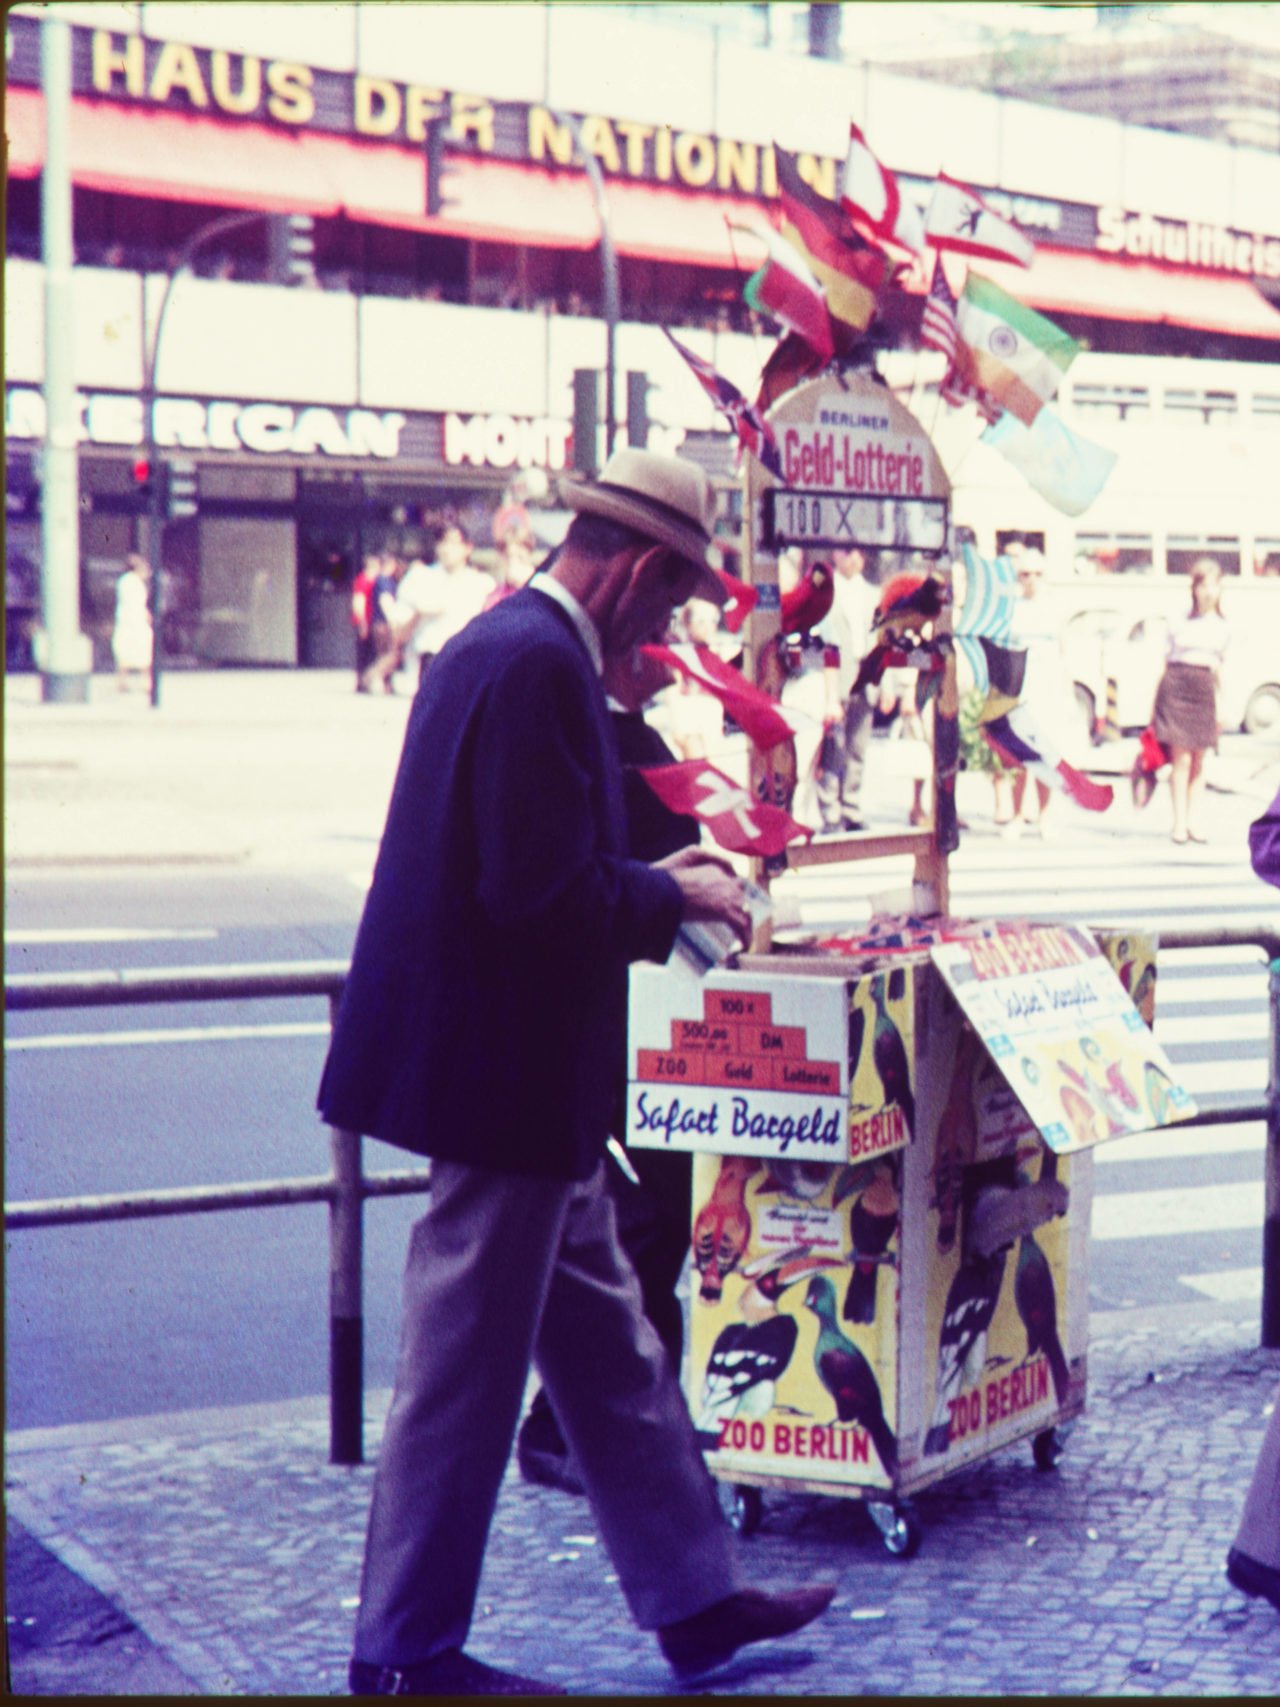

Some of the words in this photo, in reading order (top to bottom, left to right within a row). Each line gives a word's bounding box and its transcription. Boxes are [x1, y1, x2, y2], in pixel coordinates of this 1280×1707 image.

[92, 29, 315, 124] HAUS
[5, 388, 407, 458] AERICAN
[820, 410, 889, 430] BERLINER
[785, 428, 923, 495] Geld-Lotterie
[786, 499, 822, 534] 100
[720, 998, 744, 1015] 100
[761, 1033, 784, 1050] DM
[656, 1057, 687, 1076] ZOO
[731, 1096, 841, 1152] Bargeld
[850, 1109, 904, 1158] BERLIN
[947, 1386, 980, 1442] ZOO
[986, 1358, 1048, 1427] BERLIN
[716, 1417, 765, 1453] ZOO
[773, 1423, 870, 1464] BERLIN
